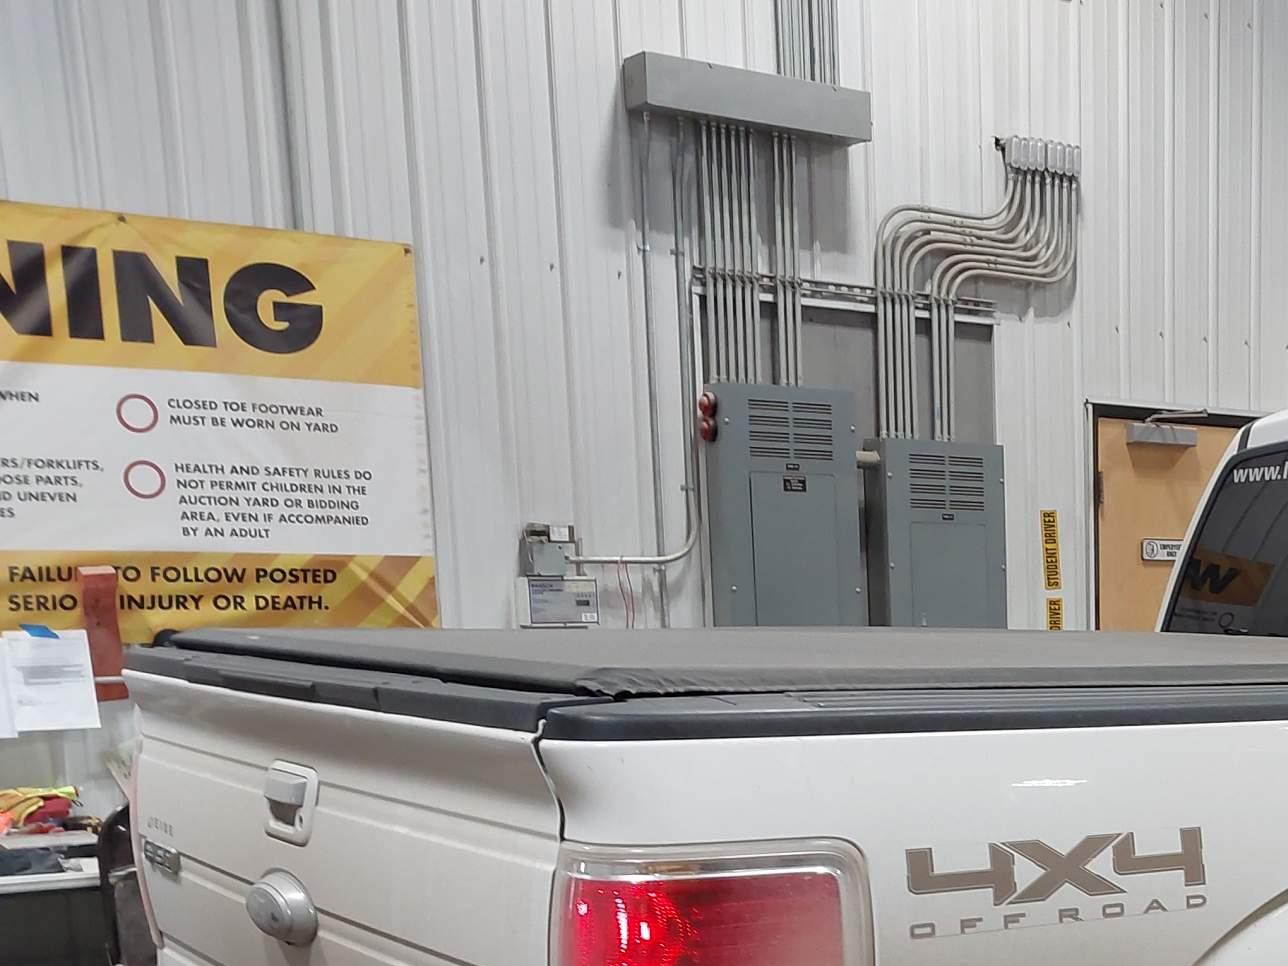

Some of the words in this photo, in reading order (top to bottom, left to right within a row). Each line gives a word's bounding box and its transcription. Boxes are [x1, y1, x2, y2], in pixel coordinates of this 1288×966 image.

[168, 398, 218, 411] CLOSED
[223, 401, 247, 412] TOE
[252, 403, 323, 417] FOOTWEAR
[169, 415, 206, 426] MUST
[212, 417, 226, 427] BE
[231, 418, 275, 430] WORN
[280, 420, 301, 431] ON
[305, 422, 339, 433] YARD
[0, 474, 31, 485] OSE
[35, 475, 82, 488] PARTS,
[174, 463, 225, 475] HEALTH
[230, 465, 260, 476] AND
[264, 467, 309, 478] SAFETY
[314, 469, 351, 480] RULES
[354, 471, 372, 481] DO
[176, 480, 205, 490] NOT
[210, 482, 258, 492] PERMIT
[261, 482, 324, 495] CHILDREN
[328, 485, 342, 495] IN
[346, 485, 367, 496] THE
[17, 492, 77, 503] UNEVEN
[178, 496, 240, 507] AUCTION
[244, 497, 279, 508] YARD
[284, 499, 303, 509] OR
[307, 500, 359, 511] BIDDING
[180, 512, 220, 523] AREA,
[225, 512, 259, 523] EVEN
[263, 513, 274, 523] IF
[278, 514, 369, 526] ACCOMPANIED
[1043, 511, 1056, 544] DRIVER
[182, 527, 198, 537] BY
[204, 528, 225, 538] AN
[229, 528, 271, 539] ADULT
[8, 566, 80, 583] FAILU
[116, 566, 141, 582] TO
[151, 567, 246, 584] FOLLOW
[255, 568, 337, 585] POSTED
[1046, 547, 1060, 588] STUDENT
[8, 594, 78, 612] SERIO
[120, 594, 203, 611] INJURY
[212, 595, 247, 611] OR
[255, 595, 329, 611] DEATH.
